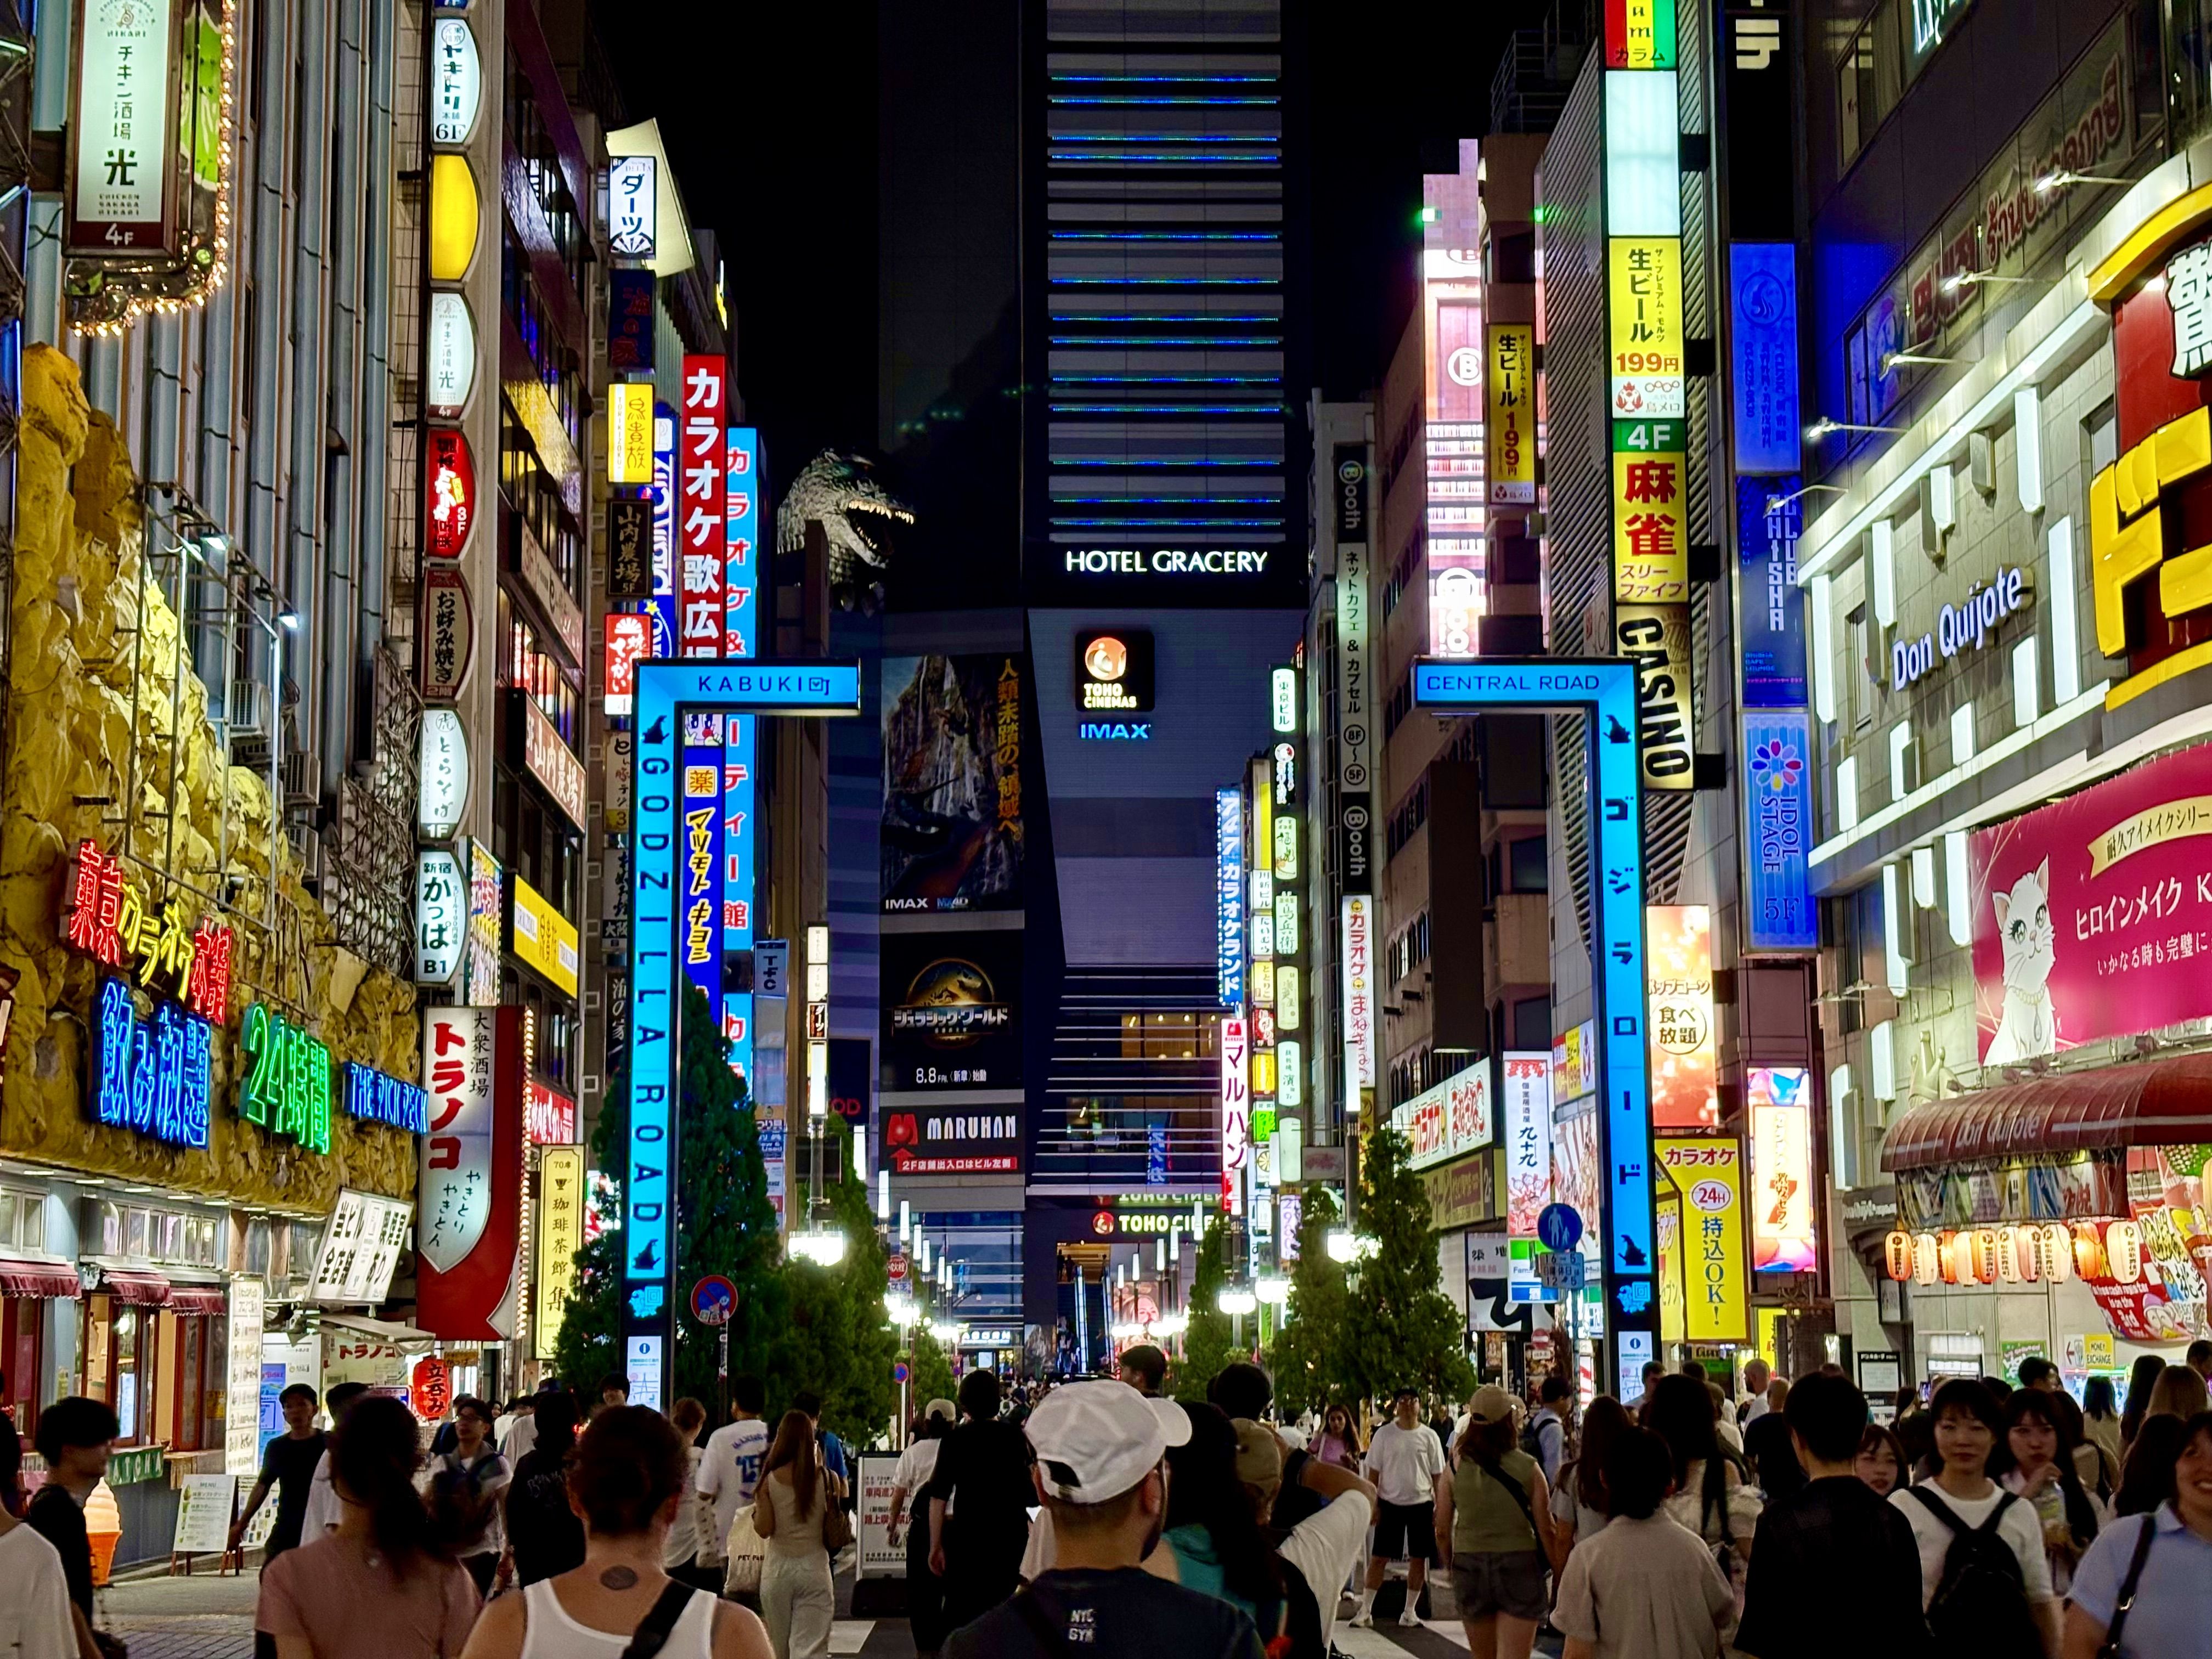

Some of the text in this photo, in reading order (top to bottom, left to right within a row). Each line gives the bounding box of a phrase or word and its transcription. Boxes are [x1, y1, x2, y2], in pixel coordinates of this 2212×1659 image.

[114, 46, 133, 140] チキン酒場
[436, 123, 466, 140] 6F
[103, 148, 138, 186] 光
[622, 173, 646, 236] ダーツ
[105, 223, 134, 245] 4F
[1627, 248, 1654, 343] 生ビール
[438, 371, 455, 388] 光
[1498, 334, 1519, 408] 生ビール
[1616, 352, 1679, 373] 199円
[1504, 411, 1520, 477] 199円
[1627, 424, 1671, 450] 4F
[1339, 460, 1364, 530] Booth
[1623, 459, 1677, 557] 麻雀
[458, 506, 467, 535] 3F
[614, 505, 642, 583] 山内農場
[1784, 494, 1798, 585] CLUB
[1066, 550, 1268, 573] HOTEL GRACERY
[1620, 565, 1669, 580] スリー
[1619, 582, 1685, 599] ファイブ
[435, 591, 456, 684] お好み焼き
[1346, 551, 1362, 714] ネットカフェ & カプセル
[1892, 565, 2024, 692] Don Quijote
[1084, 682, 1123, 697] TOHO
[1084, 696, 1137, 708] CINEMAS
[1278, 681, 1290, 726] 東京ビル
[1426, 674, 1600, 691] CENTRAL ROAD
[1080, 724, 1149, 740] IMAX
[435, 736, 453, 818] とらそば
[535, 718, 579, 817] 山内農場
[687, 769, 715, 795] 薬
[426, 824, 449, 838] 1F
[1344, 805, 1369, 877] Booth
[1760, 795, 1781, 873] STAGE
[1779, 796, 1801, 860] IDOL
[2106, 805, 2211, 863] 耐久アイメイクシリー
[422, 862, 453, 874] 新宿
[686, 806, 716, 965] マツモトキヨシ
[421, 876, 453, 951] かっぱ
[636, 757, 672, 1045] GODZILLA
[885, 898, 929, 910] IMAX
[1764, 897, 1800, 921] 5F
[2075, 876, 2182, 941] ヒロインメイク
[423, 960, 448, 975] B1
[1350, 915, 1368, 978] カラオケ
[2097, 930, 2209, 977] いかなる時も完璧に
[1604, 796, 1641, 1185] ゴジラロード
[894, 1007, 1008, 1029] ジュラシック・ワールド
[1658, 1006, 1696, 1024] 食べ
[1659, 1027, 1698, 1045] 放題
[97, 980, 210, 1148] 飲み放題
[469, 1011, 490, 1097] 大衆酒場
[916, 1068, 936, 1084] 8.8
[246, 1004, 330, 1153] 24時間
[351, 1065, 374, 1115] THE
[428, 1022, 466, 1170] トラノコ
[927, 1115, 1017, 1140] MARUHAN
[1224, 1045, 1247, 1170] マルハン
[632, 1084, 665, 1222] ROAD
[1517, 1125, 1538, 1168] 九十九
[1664, 1147, 1736, 1167] カラオケ
[1955, 1121, 1984, 1149] Don
[428, 1182, 459, 1247] やきとん
[453, 1170, 481, 1234] やきとり
[1697, 1187, 1726, 1206] 24H
[1118, 1215, 1169, 1232] TOHO
[1701, 1216, 1726, 1326] 持込OK!
[338, 1344, 396, 1360] トラノコ
[2086, 1354, 2113, 1365] EXCHANGE
[2089, 1342, 2107, 1353] MONEY
[425, 1363, 446, 1413] 立呑み
